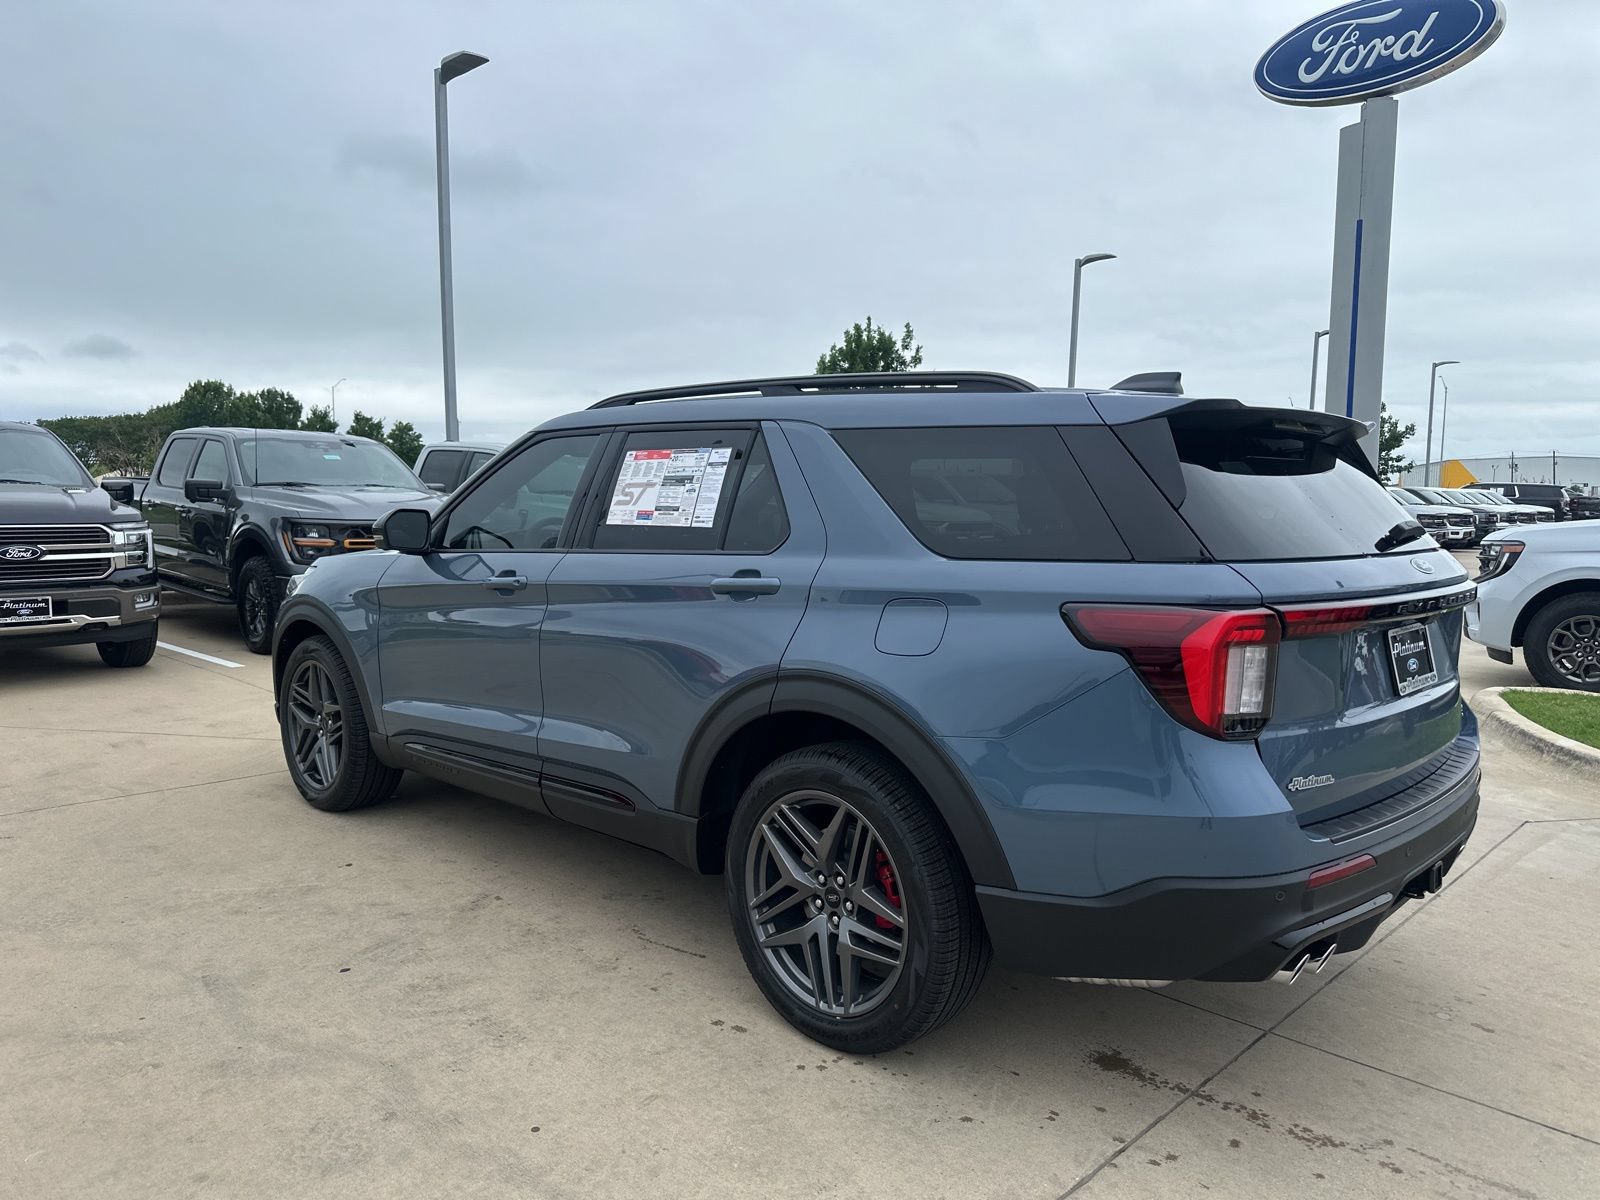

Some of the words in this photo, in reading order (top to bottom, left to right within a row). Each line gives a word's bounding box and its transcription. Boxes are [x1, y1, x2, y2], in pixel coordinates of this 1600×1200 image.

[1298, 8, 1439, 83] Ford
[613, 482, 658, 506] ST
[6, 548, 32, 558] Ford
[1393, 640, 1426, 657] Platinum
[1288, 774, 1335, 791] Platinum
